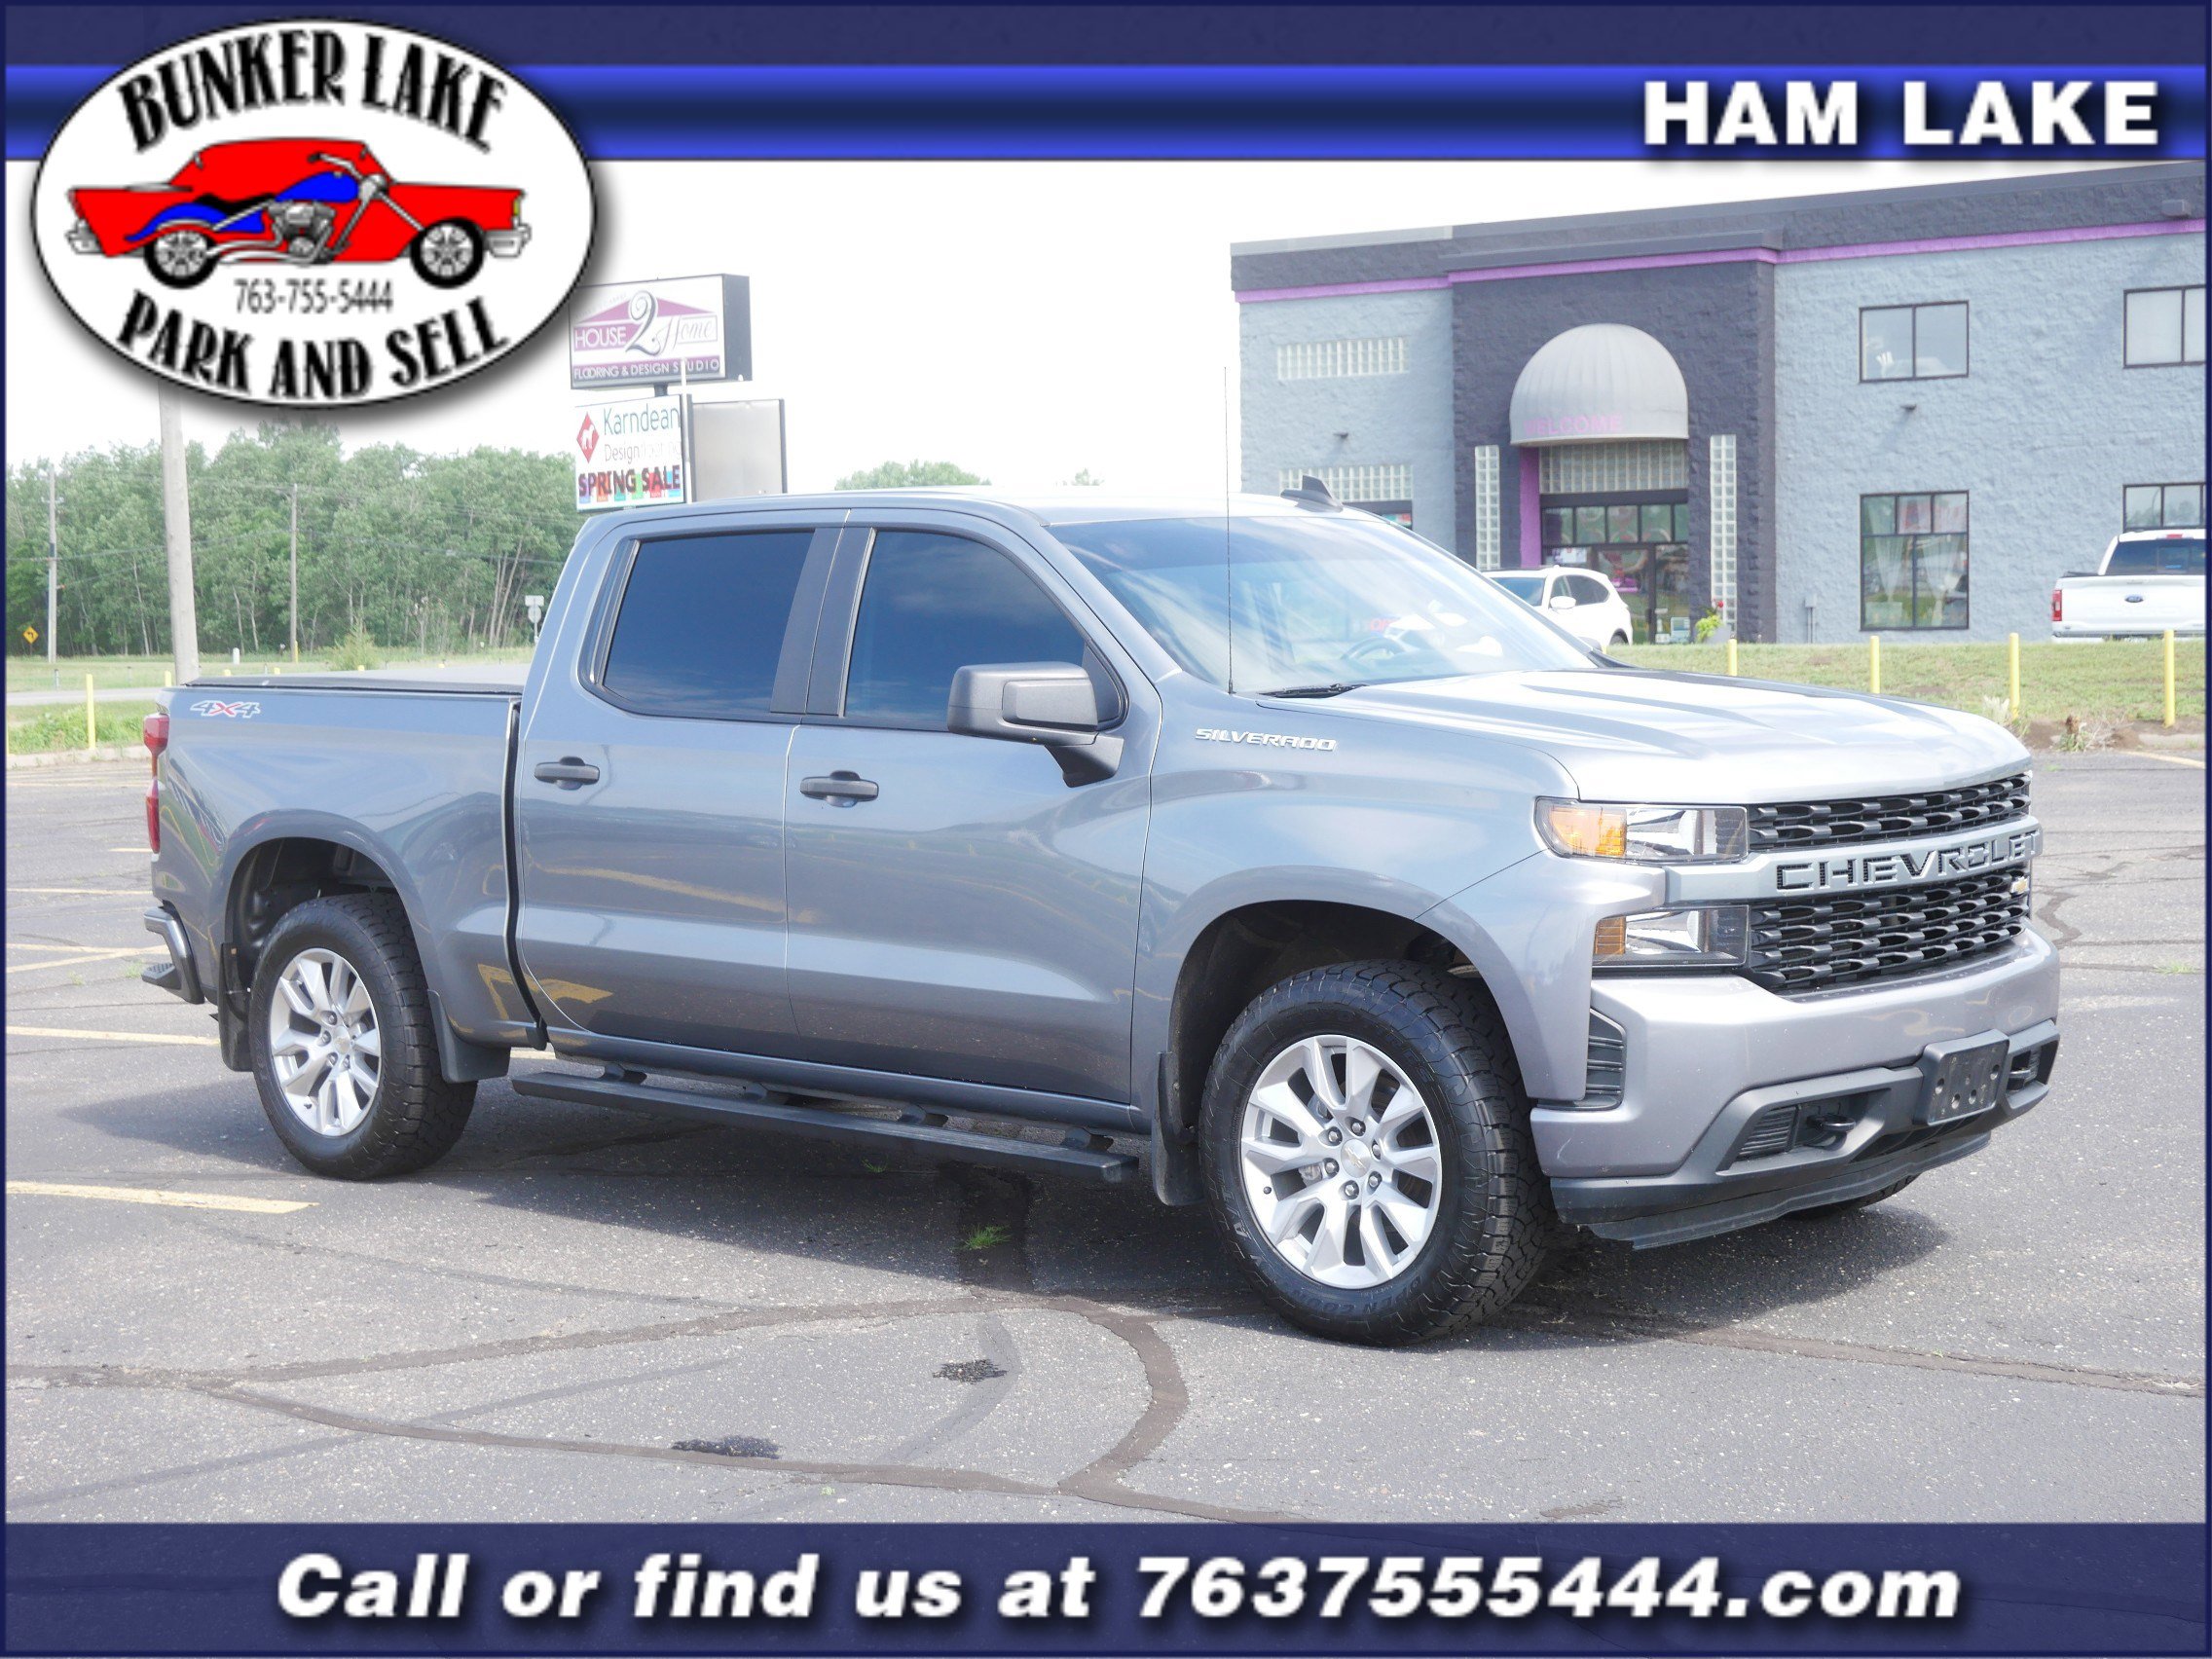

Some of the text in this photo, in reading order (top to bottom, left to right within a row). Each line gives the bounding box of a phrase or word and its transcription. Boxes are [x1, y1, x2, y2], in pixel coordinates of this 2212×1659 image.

[574, 326, 627, 349] HOUSE
[573, 365, 619, 380] FLOORING
[631, 362, 670, 376] DESIGN
[673, 357, 720, 372] SUDIO
[604, 403, 681, 435] Karndean
[1523, 414, 1624, 435] WELCOME
[578, 464, 681, 498] SPRING SALE
[1195, 728, 1337, 752] SILVERADO
[1776, 829, 2042, 893] CHEVROLET
